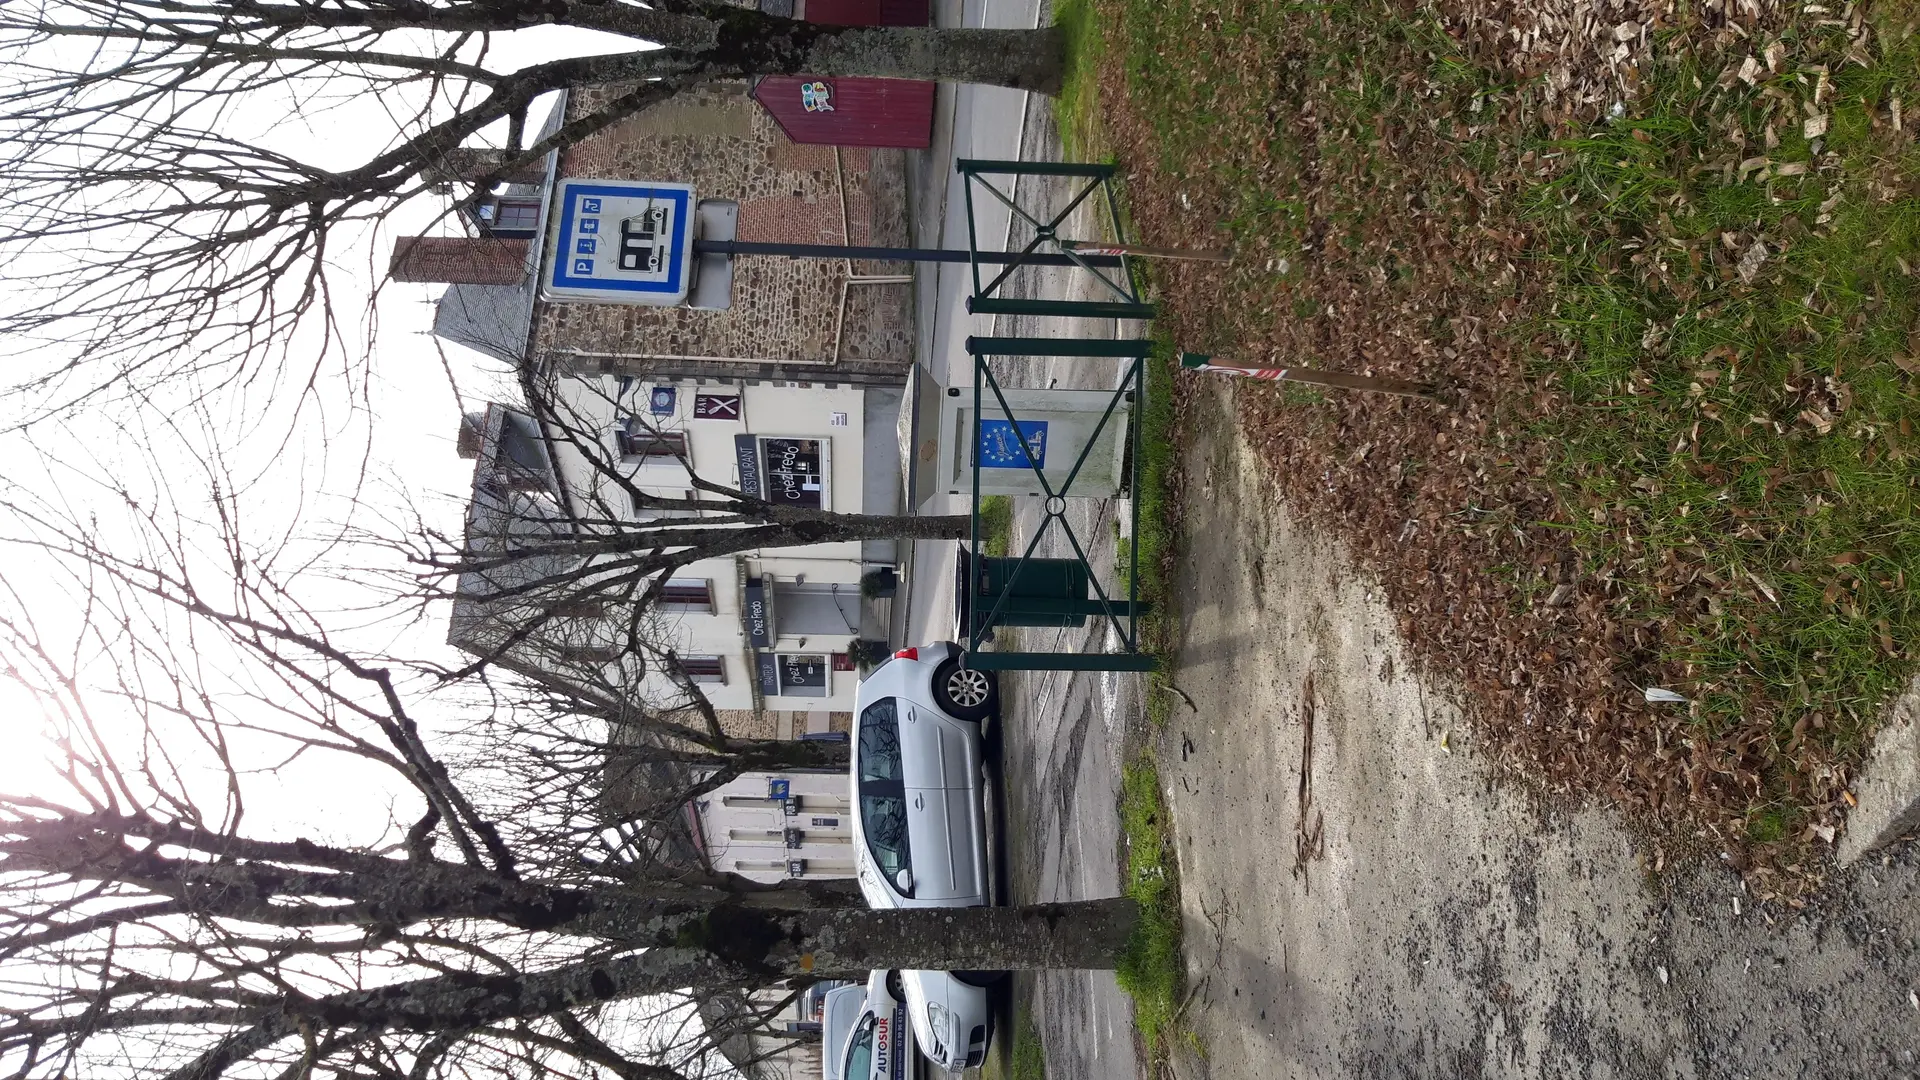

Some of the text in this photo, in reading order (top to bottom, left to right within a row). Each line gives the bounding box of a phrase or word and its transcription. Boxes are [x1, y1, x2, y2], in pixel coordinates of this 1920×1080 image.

[577, 262, 590, 271] P
[697, 397, 708, 414] BAR
[740, 446, 757, 494] RESTAURANT
[777, 446, 801, 499] Chez Fredo
[750, 601, 764, 636] Chez Fredo
[762, 664, 774, 686] TRAITEUR
[789, 667, 805, 684] Chez
[785, 805, 796, 815] PUB
[792, 863, 801, 872] BAR
[877, 1018, 888, 1074] AUTOSUR
